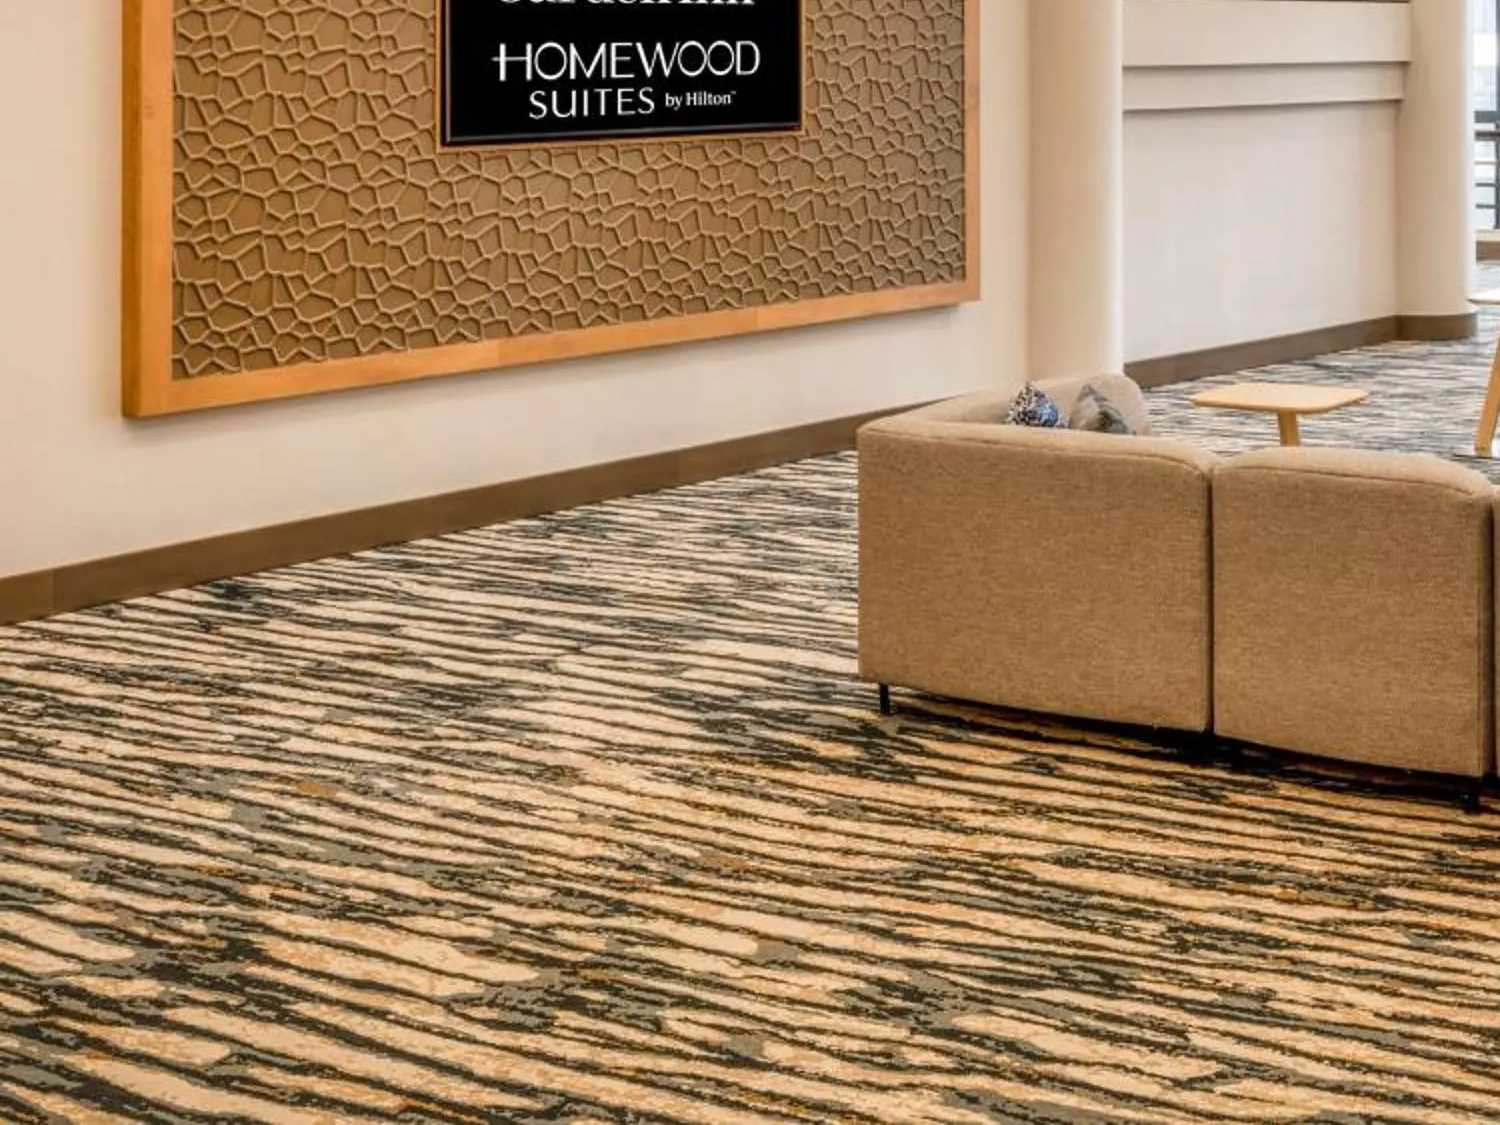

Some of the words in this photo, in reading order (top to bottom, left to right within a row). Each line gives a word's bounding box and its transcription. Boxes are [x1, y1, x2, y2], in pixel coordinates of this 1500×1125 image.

[492, 40, 761, 82] HOMEWOOD
[529, 87, 656, 120] SUITES
[665, 91, 683, 110] by
[685, 91, 732, 107] Hilton
